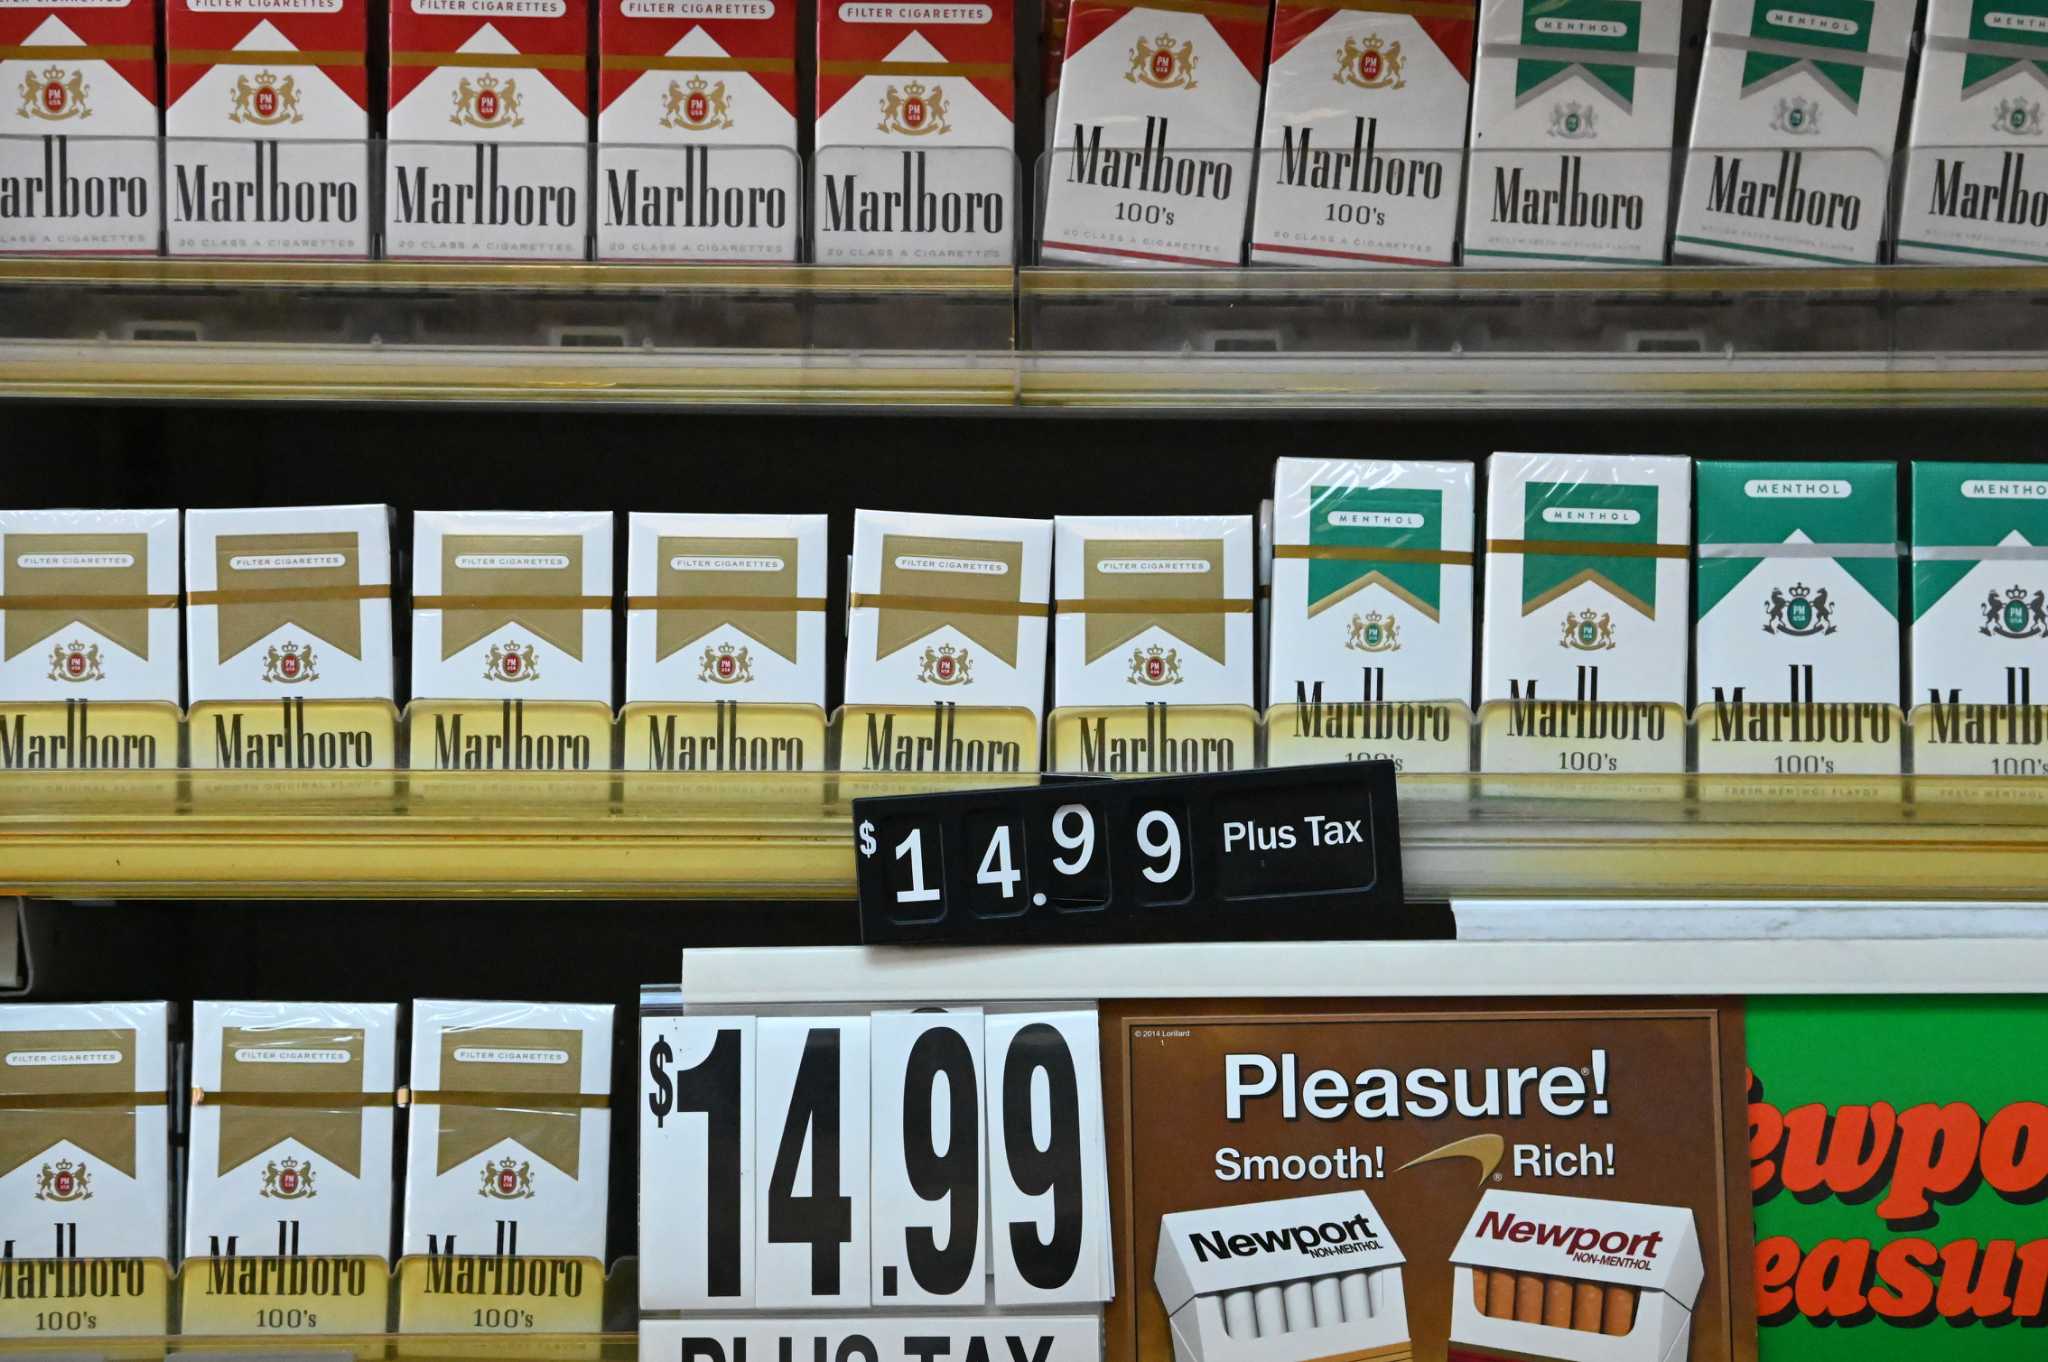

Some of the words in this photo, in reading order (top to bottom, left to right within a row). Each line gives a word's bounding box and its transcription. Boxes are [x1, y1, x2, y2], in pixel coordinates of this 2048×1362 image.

[419, 0, 465, 11] FILTER
[473, 1, 558, 13] CIGARETTES
[628, 3, 675, 14] FILTER
[682, 3, 766, 15] CIGARETTES
[847, 7, 893, 18] FILTER
[899, 8, 984, 20] CIGARETTES
[1543, 20, 1619, 33] MENTHOL
[1774, 12, 1851, 32] MENTHOL
[1157, 56, 1169, 66] PM
[1365, 57, 1377, 66] PM
[48, 89, 61, 99] PM
[260, 94, 273, 104] PM
[481, 97, 493, 106] PM
[691, 99, 703, 109] PM
[908, 104, 920, 114] PM
[1067, 116, 1232, 200] Marlboro
[1276, 116, 1442, 200] Marlboro
[174, 140, 357, 222] Marlboro
[393, 143, 576, 226] Marlboro
[605, 146, 786, 228] Marlboro
[1706, 150, 1861, 231] Marlboro
[822, 151, 1003, 233] Marlboro
[1490, 156, 1643, 231] Marlboro
[1114, 201, 1175, 226] 100's
[1326, 202, 1385, 227] 100's
[1756, 484, 1841, 495] MENTHOL
[1973, 484, 2048, 496] MENTHO
[1339, 514, 1414, 525] MENTHOL
[1554, 511, 1629, 521] MENTHOL
[24, 557, 59, 565] FILTER
[236, 558, 271, 567] FILTER
[274, 556, 339, 566] CIGARETTES
[461, 558, 495, 566] FILTER
[499, 558, 563, 566] CIGARETTES
[676, 560, 710, 568] FILTER
[714, 560, 779, 568] CIGARETTES
[901, 559, 936, 569] FILTER
[938, 561, 1002, 572] CIGARETTES
[1104, 562, 1137, 570] FILTER
[1140, 562, 1205, 570] CIGARETTES
[1293, 667, 1450, 742] Marlboro
[1507, 665, 1665, 742] Marlboro
[1711, 664, 1891, 743] Marlboro
[1927, 667, 2048, 745] Marlb
[0, 698, 156, 769] Marlboro
[214, 697, 373, 769] Marlboro
[433, 698, 590, 770] Marlboro
[648, 700, 803, 772] Marlboro
[862, 701, 1020, 772] Marlboro
[1078, 702, 1234, 773] Marlboro
[1558, 751, 1618, 771] 100's
[1774, 755, 1834, 773] 100's
[1223, 819, 1297, 852] Plus
[1304, 815, 1365, 847] Tax
[12, 1055, 47, 1063] FILTER
[50, 1053, 116, 1062] CIGARETTES
[241, 1052, 276, 1060] FILTER
[278, 1052, 344, 1060] CIGARETTES
[460, 1051, 494, 1059] FILTER
[498, 1052, 562, 1061] CIGARETTES
[1224, 1049, 1609, 1120] Pleasure!
[1746, 1067, 2048, 1220] ewpo
[648, 1022, 1083, 1297] $14.99
[1214, 1145, 1385, 1182] Smooth!
[1512, 1143, 1616, 1177] Rich!
[1189, 1213, 1377, 1263] Newport
[1475, 1210, 1663, 1259] Newport
[205, 1220, 366, 1296] Marlboro
[424, 1220, 583, 1297] Marlboro
[1309, 1240, 1383, 1259] NON-MENTHOL
[1572, 1252, 1653, 1271] NON-MENTHOL
[36, 1311, 97, 1331] 100's
[256, 1308, 317, 1328] 100's
[473, 1308, 534, 1328] 100's
